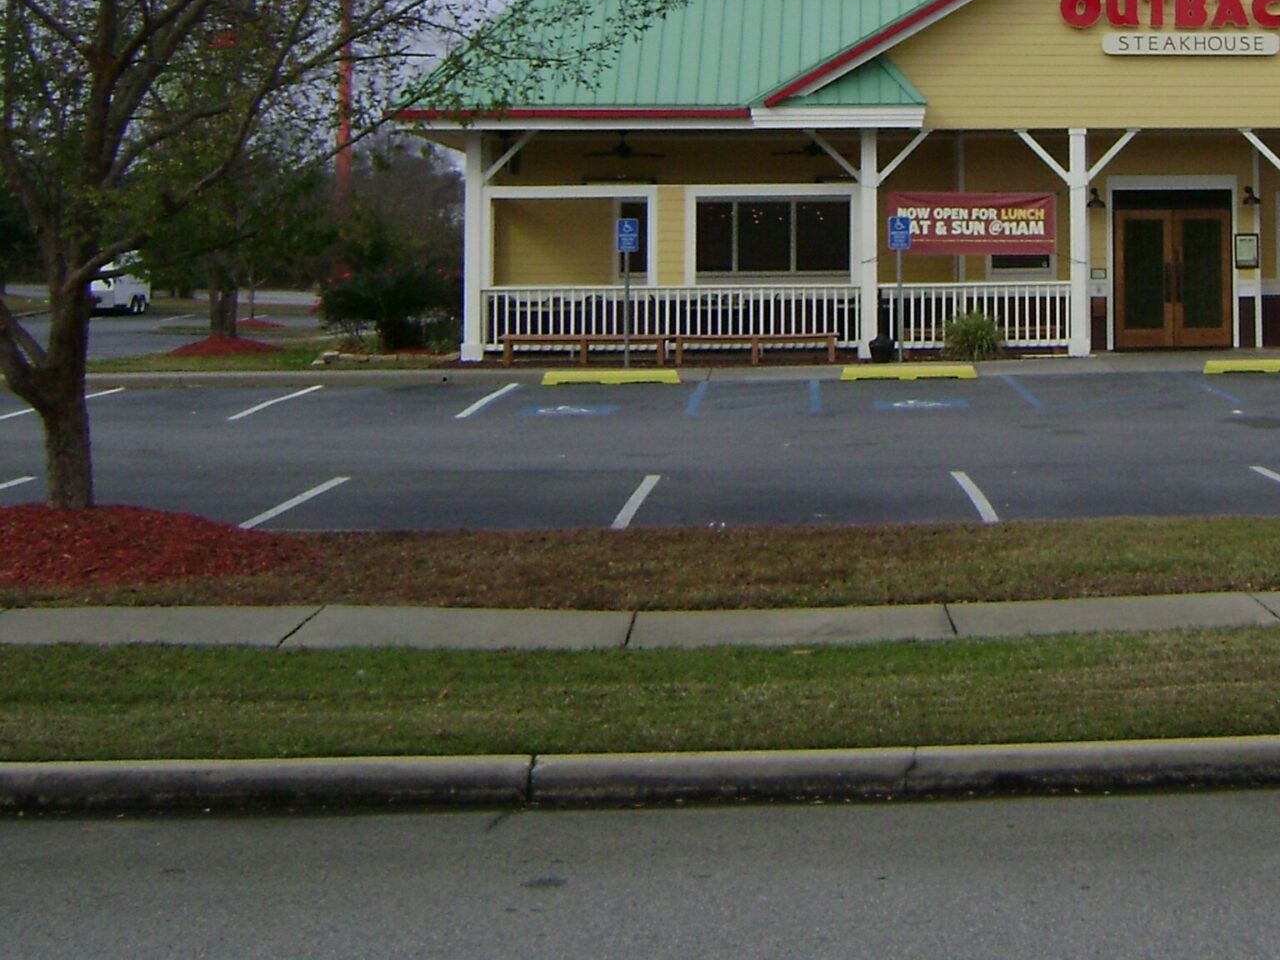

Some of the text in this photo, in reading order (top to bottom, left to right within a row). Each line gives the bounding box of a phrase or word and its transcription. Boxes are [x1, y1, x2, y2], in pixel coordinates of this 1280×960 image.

[1118, 36, 1264, 51] STEAKHOUSE
[897, 208, 1044, 219] NOW OPEN FOR LUNCH
[909, 222, 931, 234] AT
[935, 222, 948, 235] &
[951, 222, 985, 235] SUN
